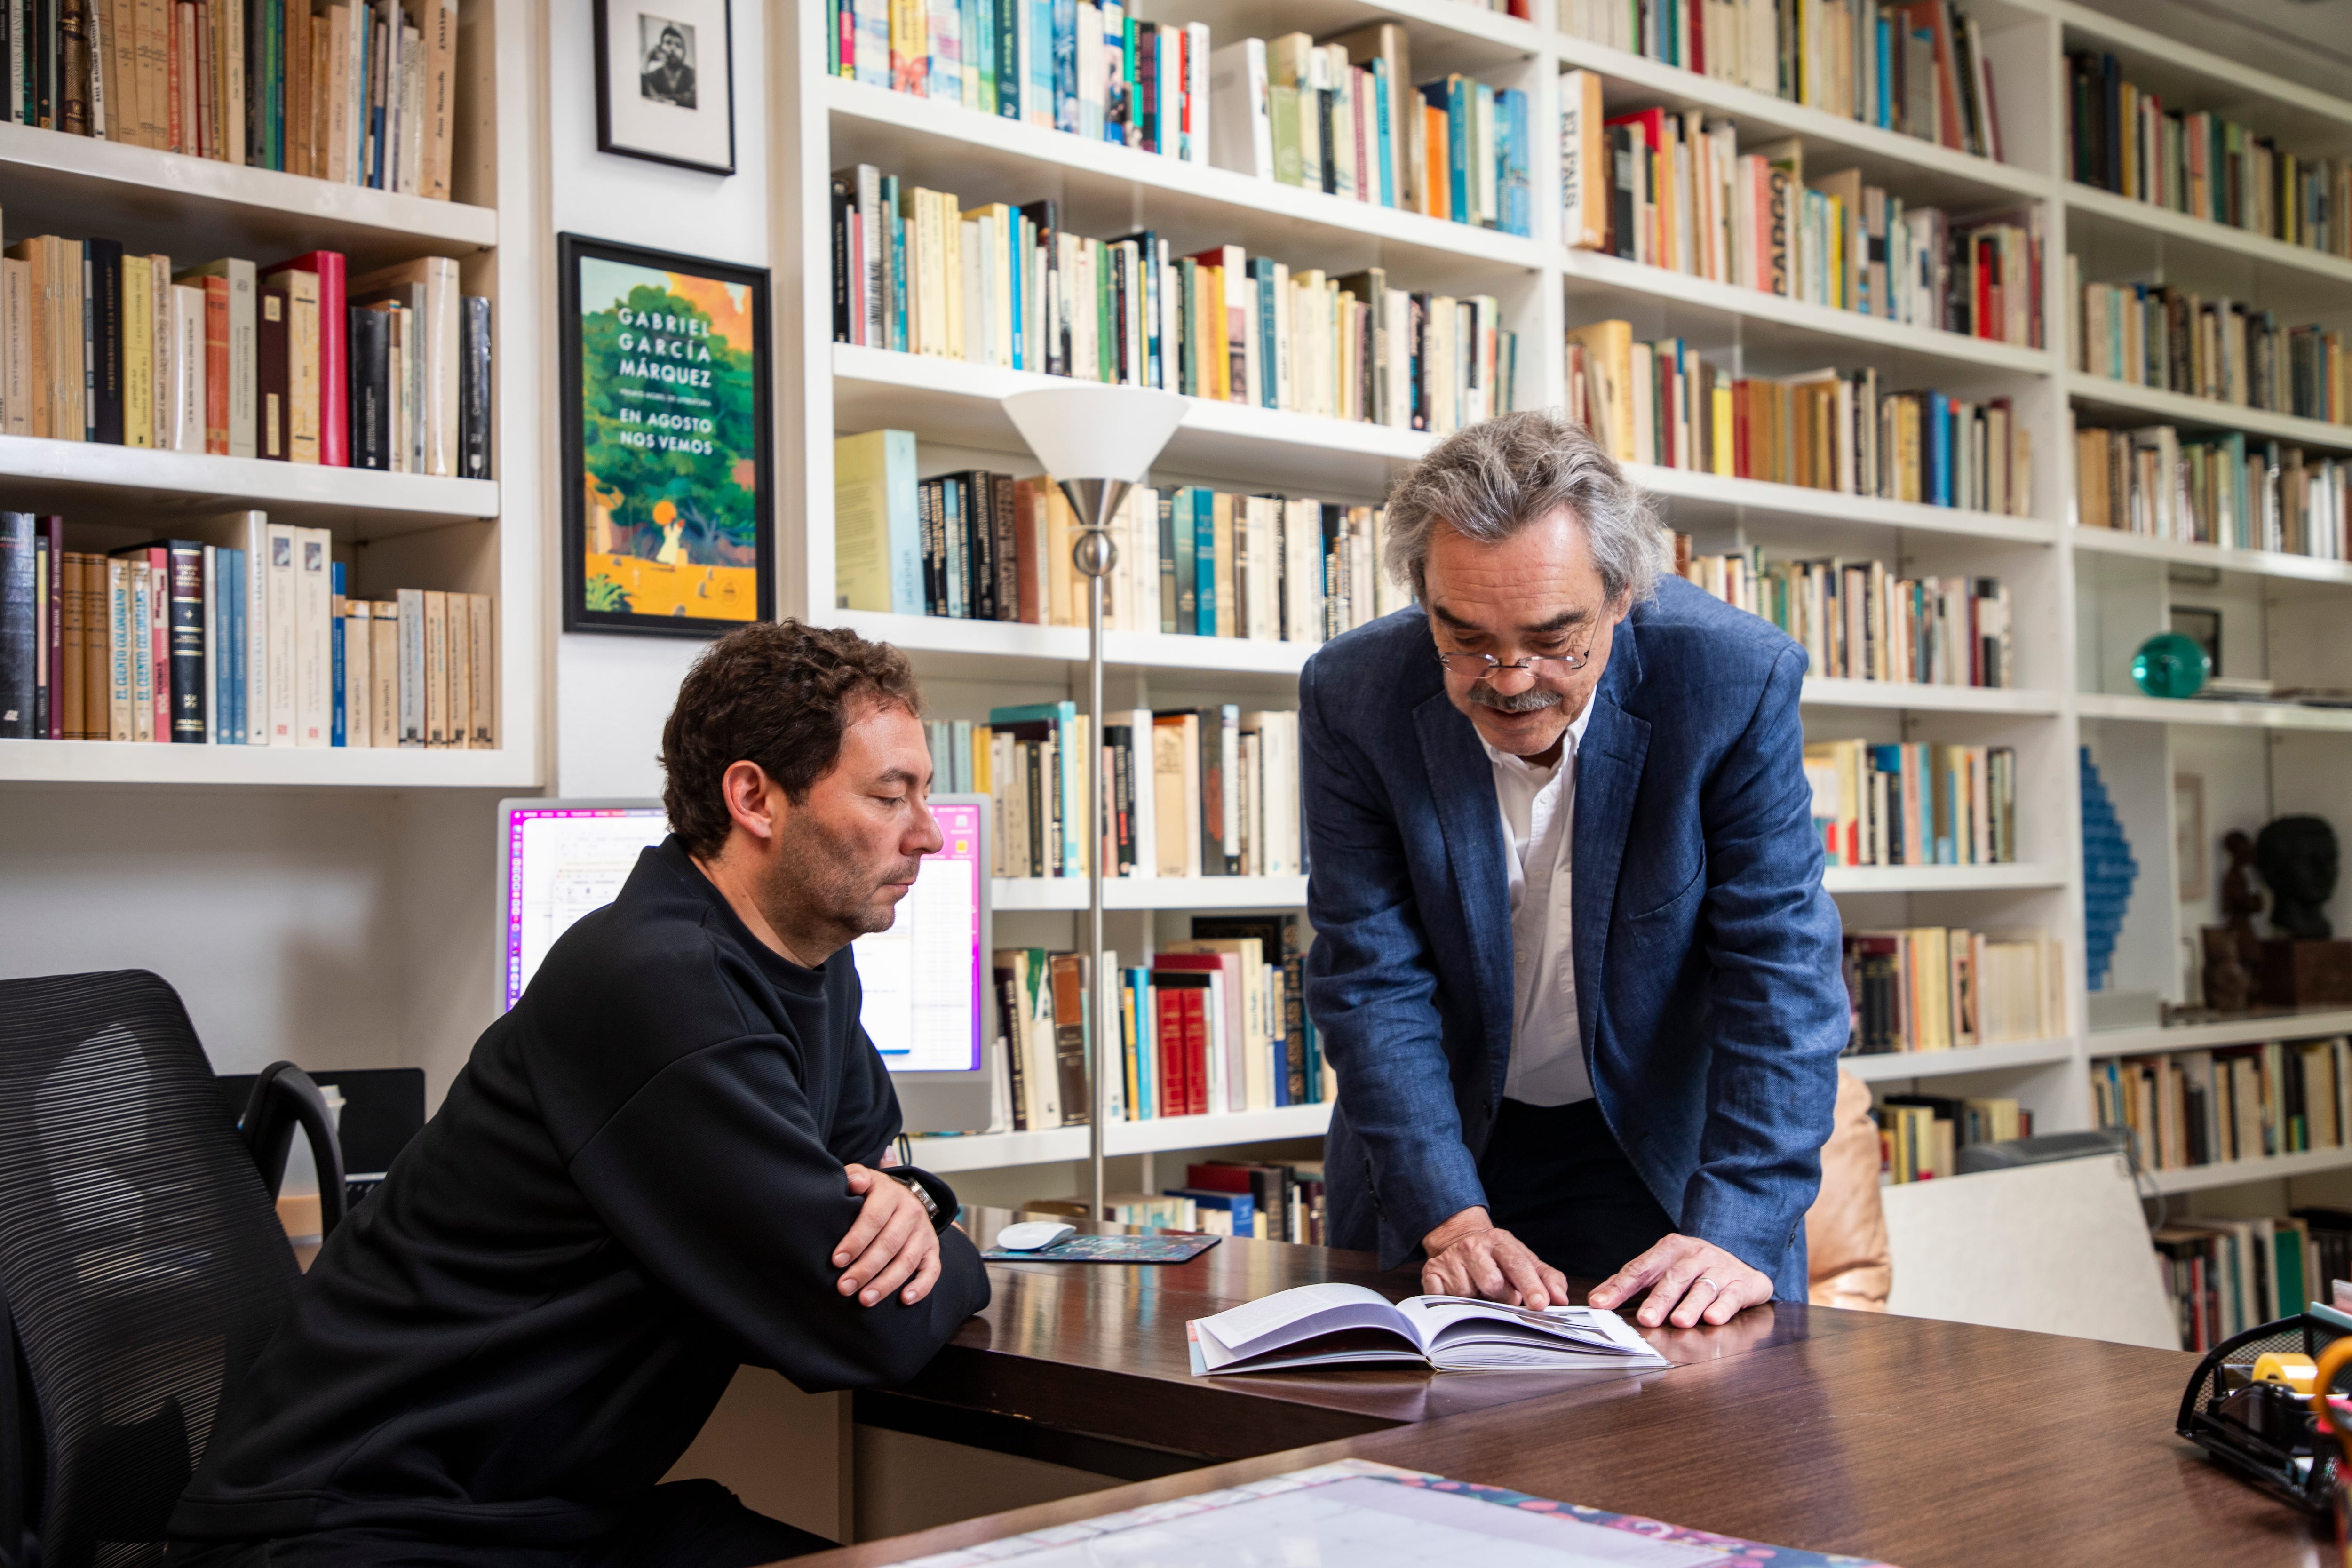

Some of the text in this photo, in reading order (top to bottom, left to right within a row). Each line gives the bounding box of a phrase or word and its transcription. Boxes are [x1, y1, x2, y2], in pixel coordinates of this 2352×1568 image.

[13, 7, 22, 92] SEAMUS HEANEY
[619, 307, 711, 338] GABRIEL
[619, 333, 711, 363] GARCÍA
[619, 358, 712, 389] MÁRQUEZ
[620, 409, 712, 434] EN AGOSTO
[620, 431, 713, 455] NOS VEMOS
[115, 589, 128, 700] EL CUENTO COLOMBIANO
[136, 652, 149, 688] CUENTO
[137, 689, 150, 701] EL
